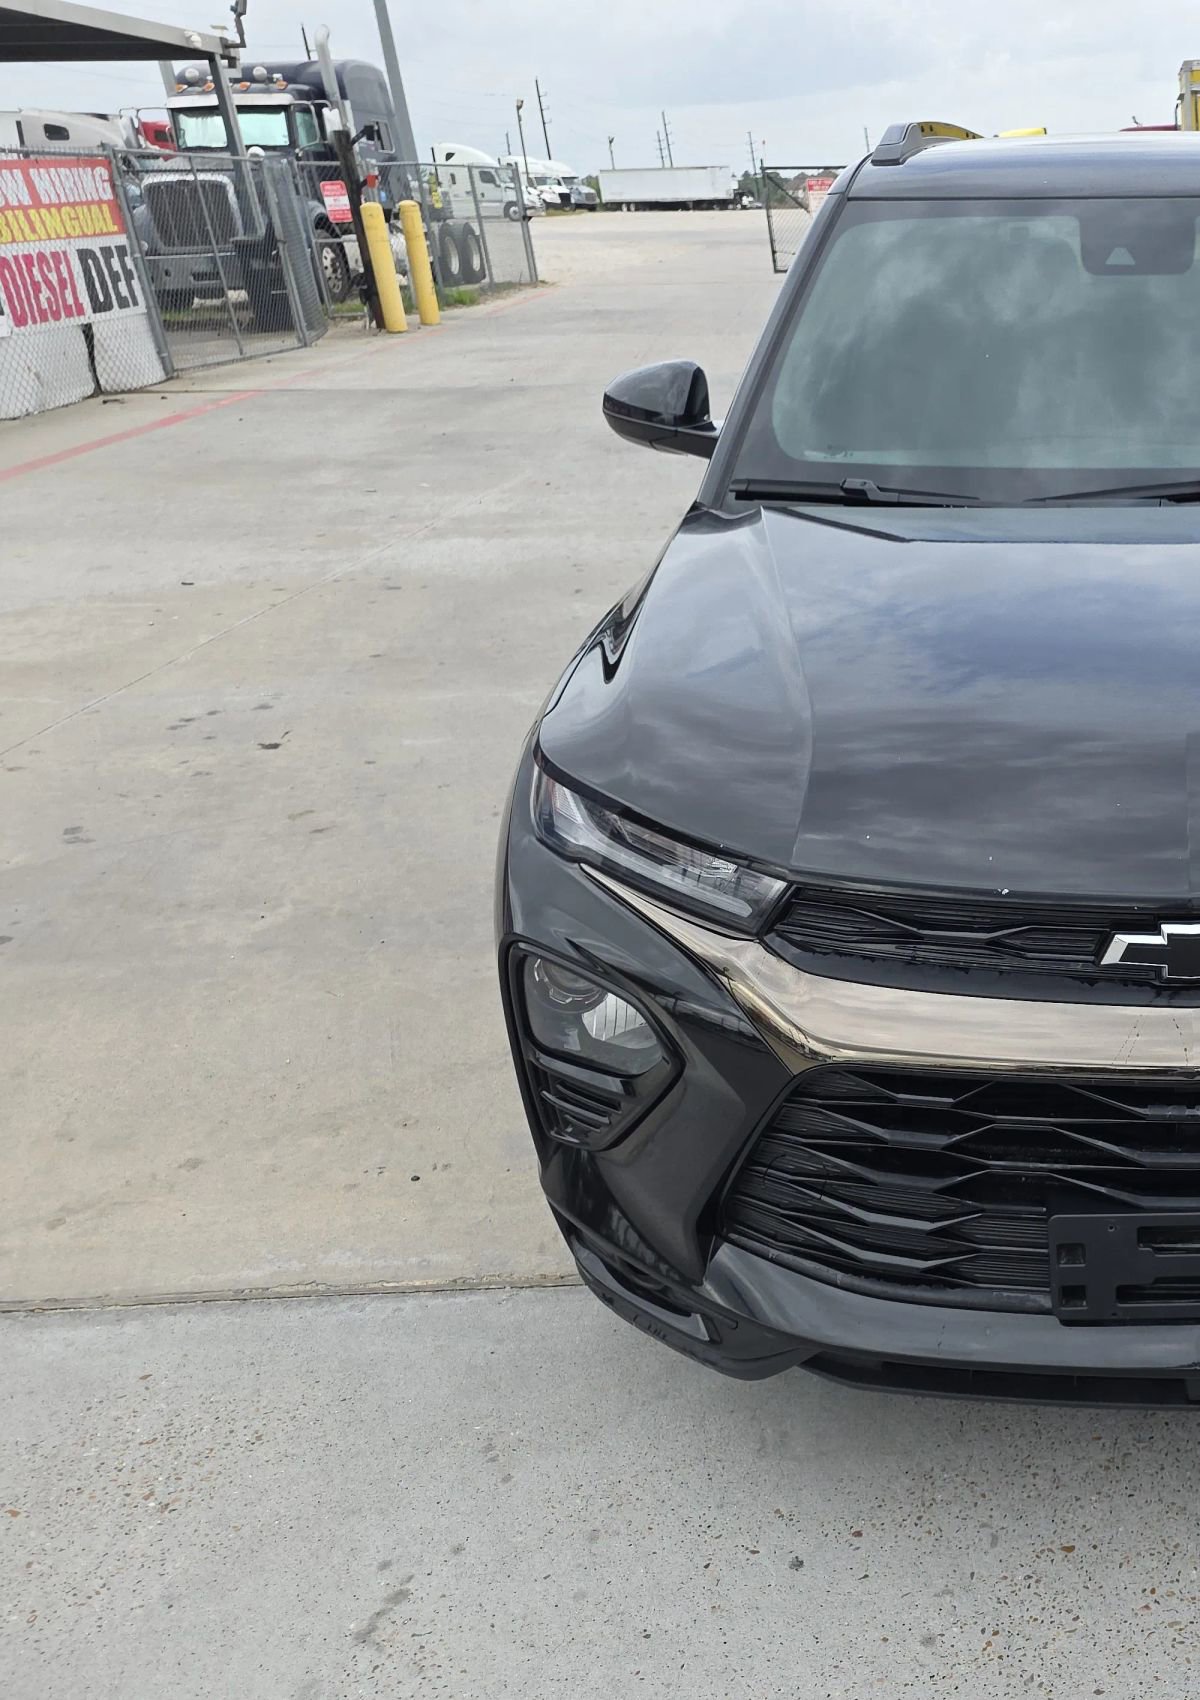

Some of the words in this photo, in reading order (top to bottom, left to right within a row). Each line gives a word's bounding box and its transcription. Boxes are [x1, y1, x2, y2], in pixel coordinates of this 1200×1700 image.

[29, 166, 114, 205] HIRING
[0, 250, 86, 328] DIESEL
[76, 244, 139, 314] DEF
